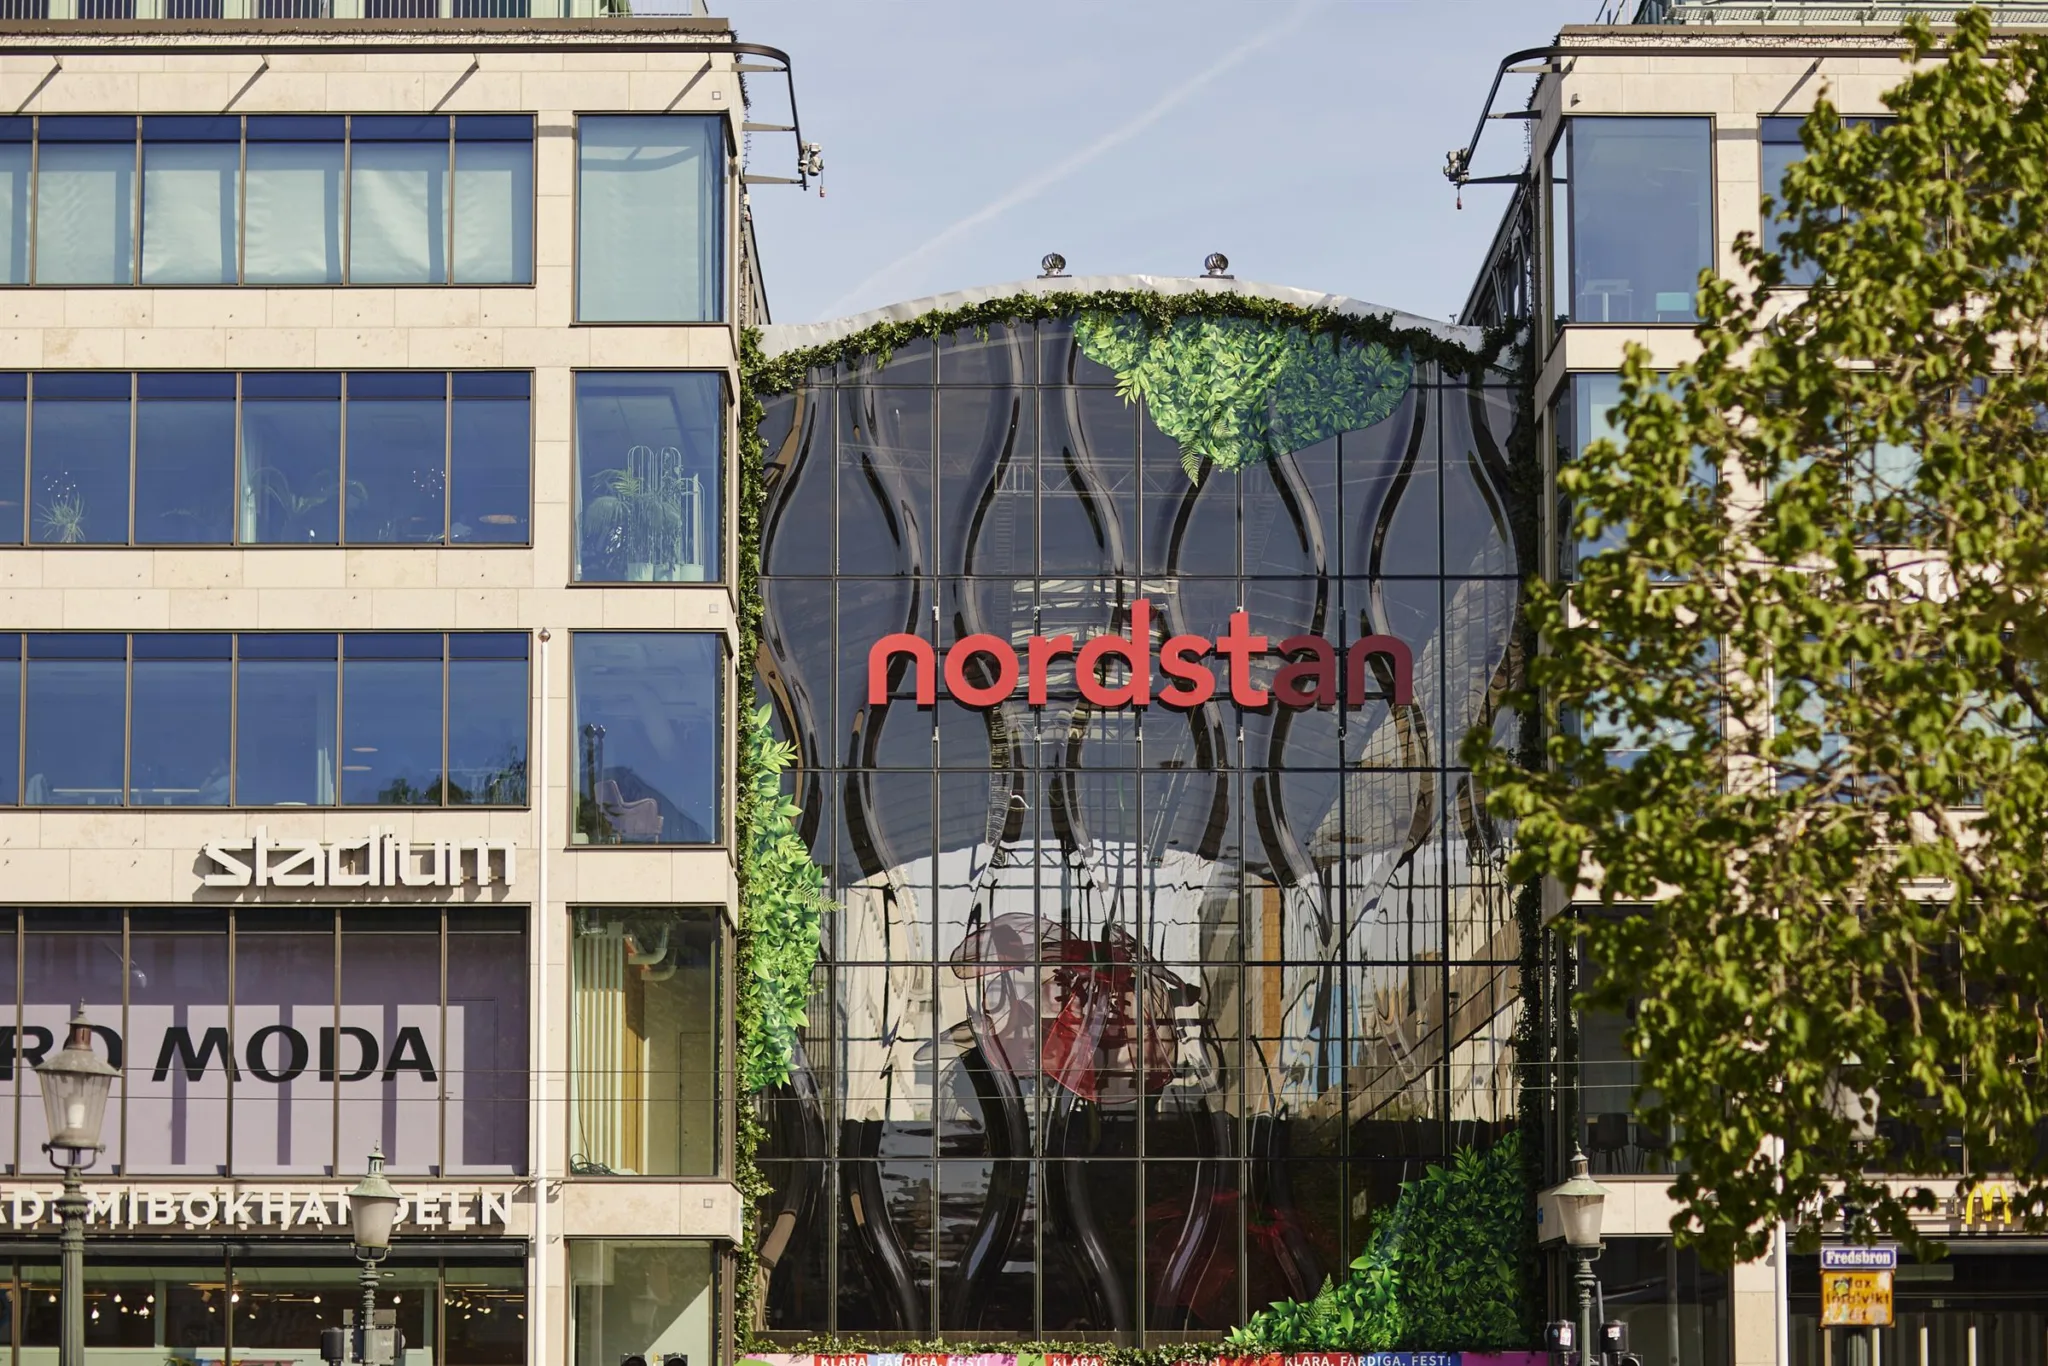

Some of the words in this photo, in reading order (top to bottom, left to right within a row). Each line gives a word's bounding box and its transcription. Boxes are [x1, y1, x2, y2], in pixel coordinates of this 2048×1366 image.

[868, 598, 1413, 706] nordstan
[205, 824, 516, 886] stadium
[152, 1024, 438, 1082] MODA
[0, 1190, 513, 1225] DMIBOKHAELN
[1826, 1250, 1891, 1265] Fredsbron
[1412, 1355, 1451, 1366] FEST!
